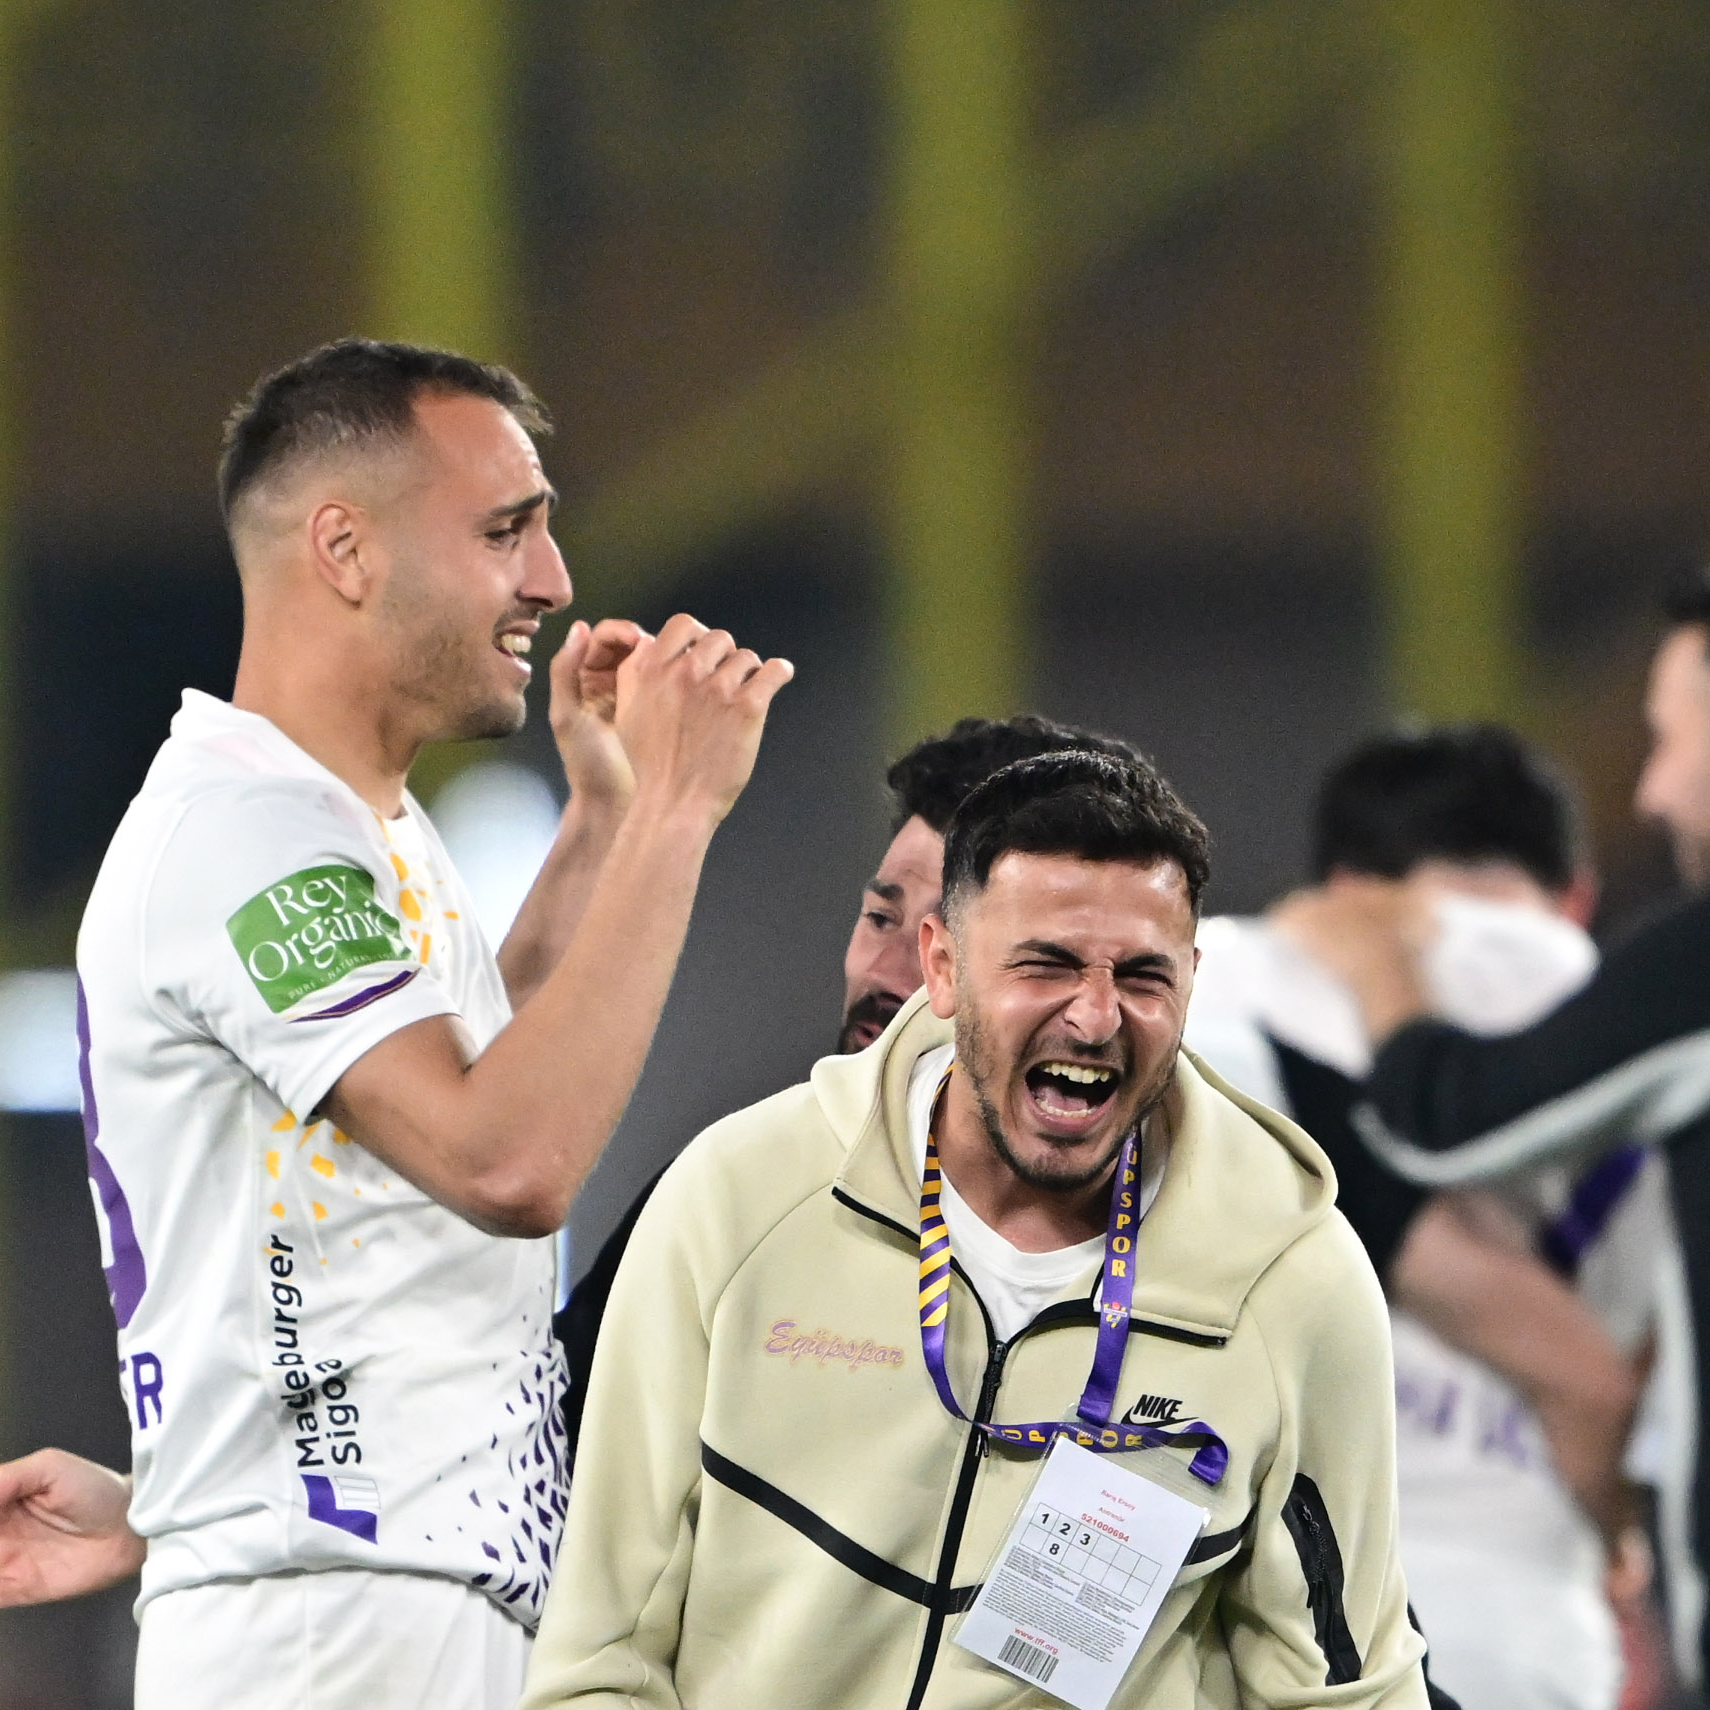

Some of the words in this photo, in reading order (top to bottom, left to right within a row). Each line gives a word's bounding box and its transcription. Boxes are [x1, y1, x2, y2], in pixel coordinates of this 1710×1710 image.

[266, 874, 347, 926] Rey
[765, 1321, 904, 1371] Eyüpspor
[1132, 1394, 1183, 1419] NIKE
[1041, 1513, 1050, 1525] 1
[1059, 1523, 1071, 1536] 2
[1079, 1533, 1091, 1546] 3
[1081, 1513, 1130, 1543] 521000694
[1048, 1543, 1060, 1556] 8
